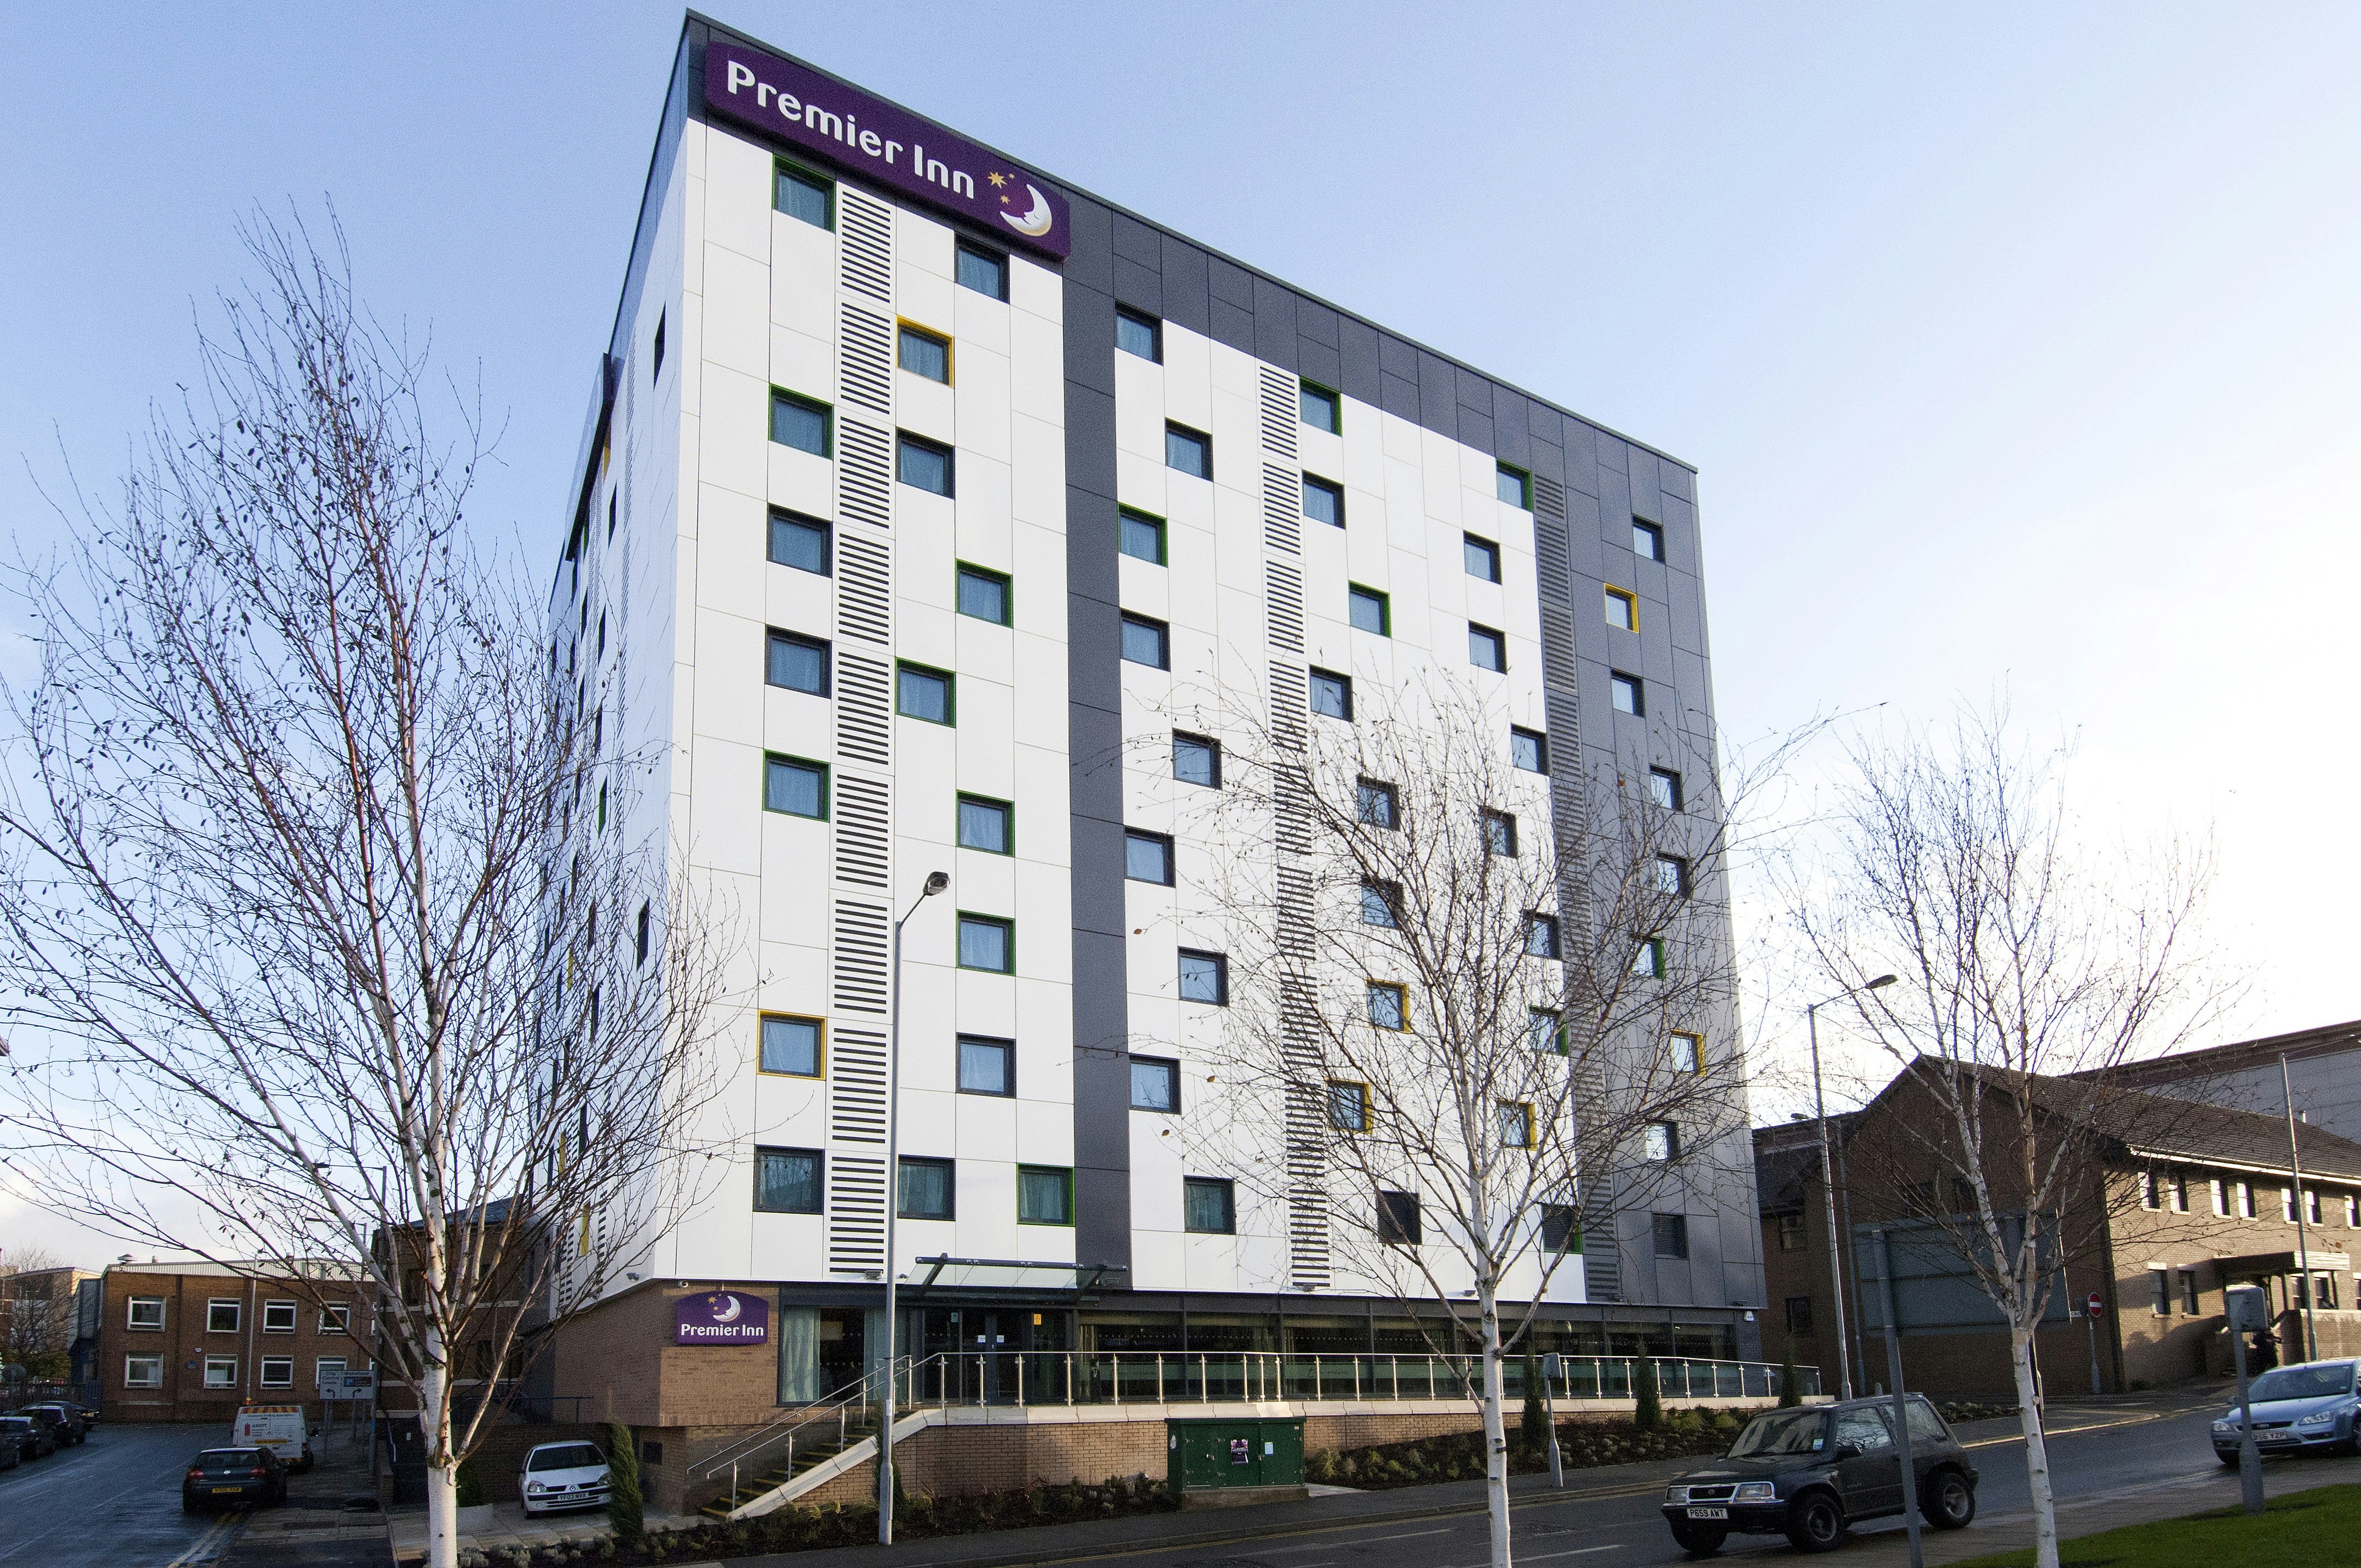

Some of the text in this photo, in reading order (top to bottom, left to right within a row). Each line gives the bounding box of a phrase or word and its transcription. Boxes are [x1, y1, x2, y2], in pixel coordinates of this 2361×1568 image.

[727, 60, 974, 199] Premier Inn
[681, 1324, 764, 1336] Premier Inn
[1710, 1509, 1724, 1517] AWT
